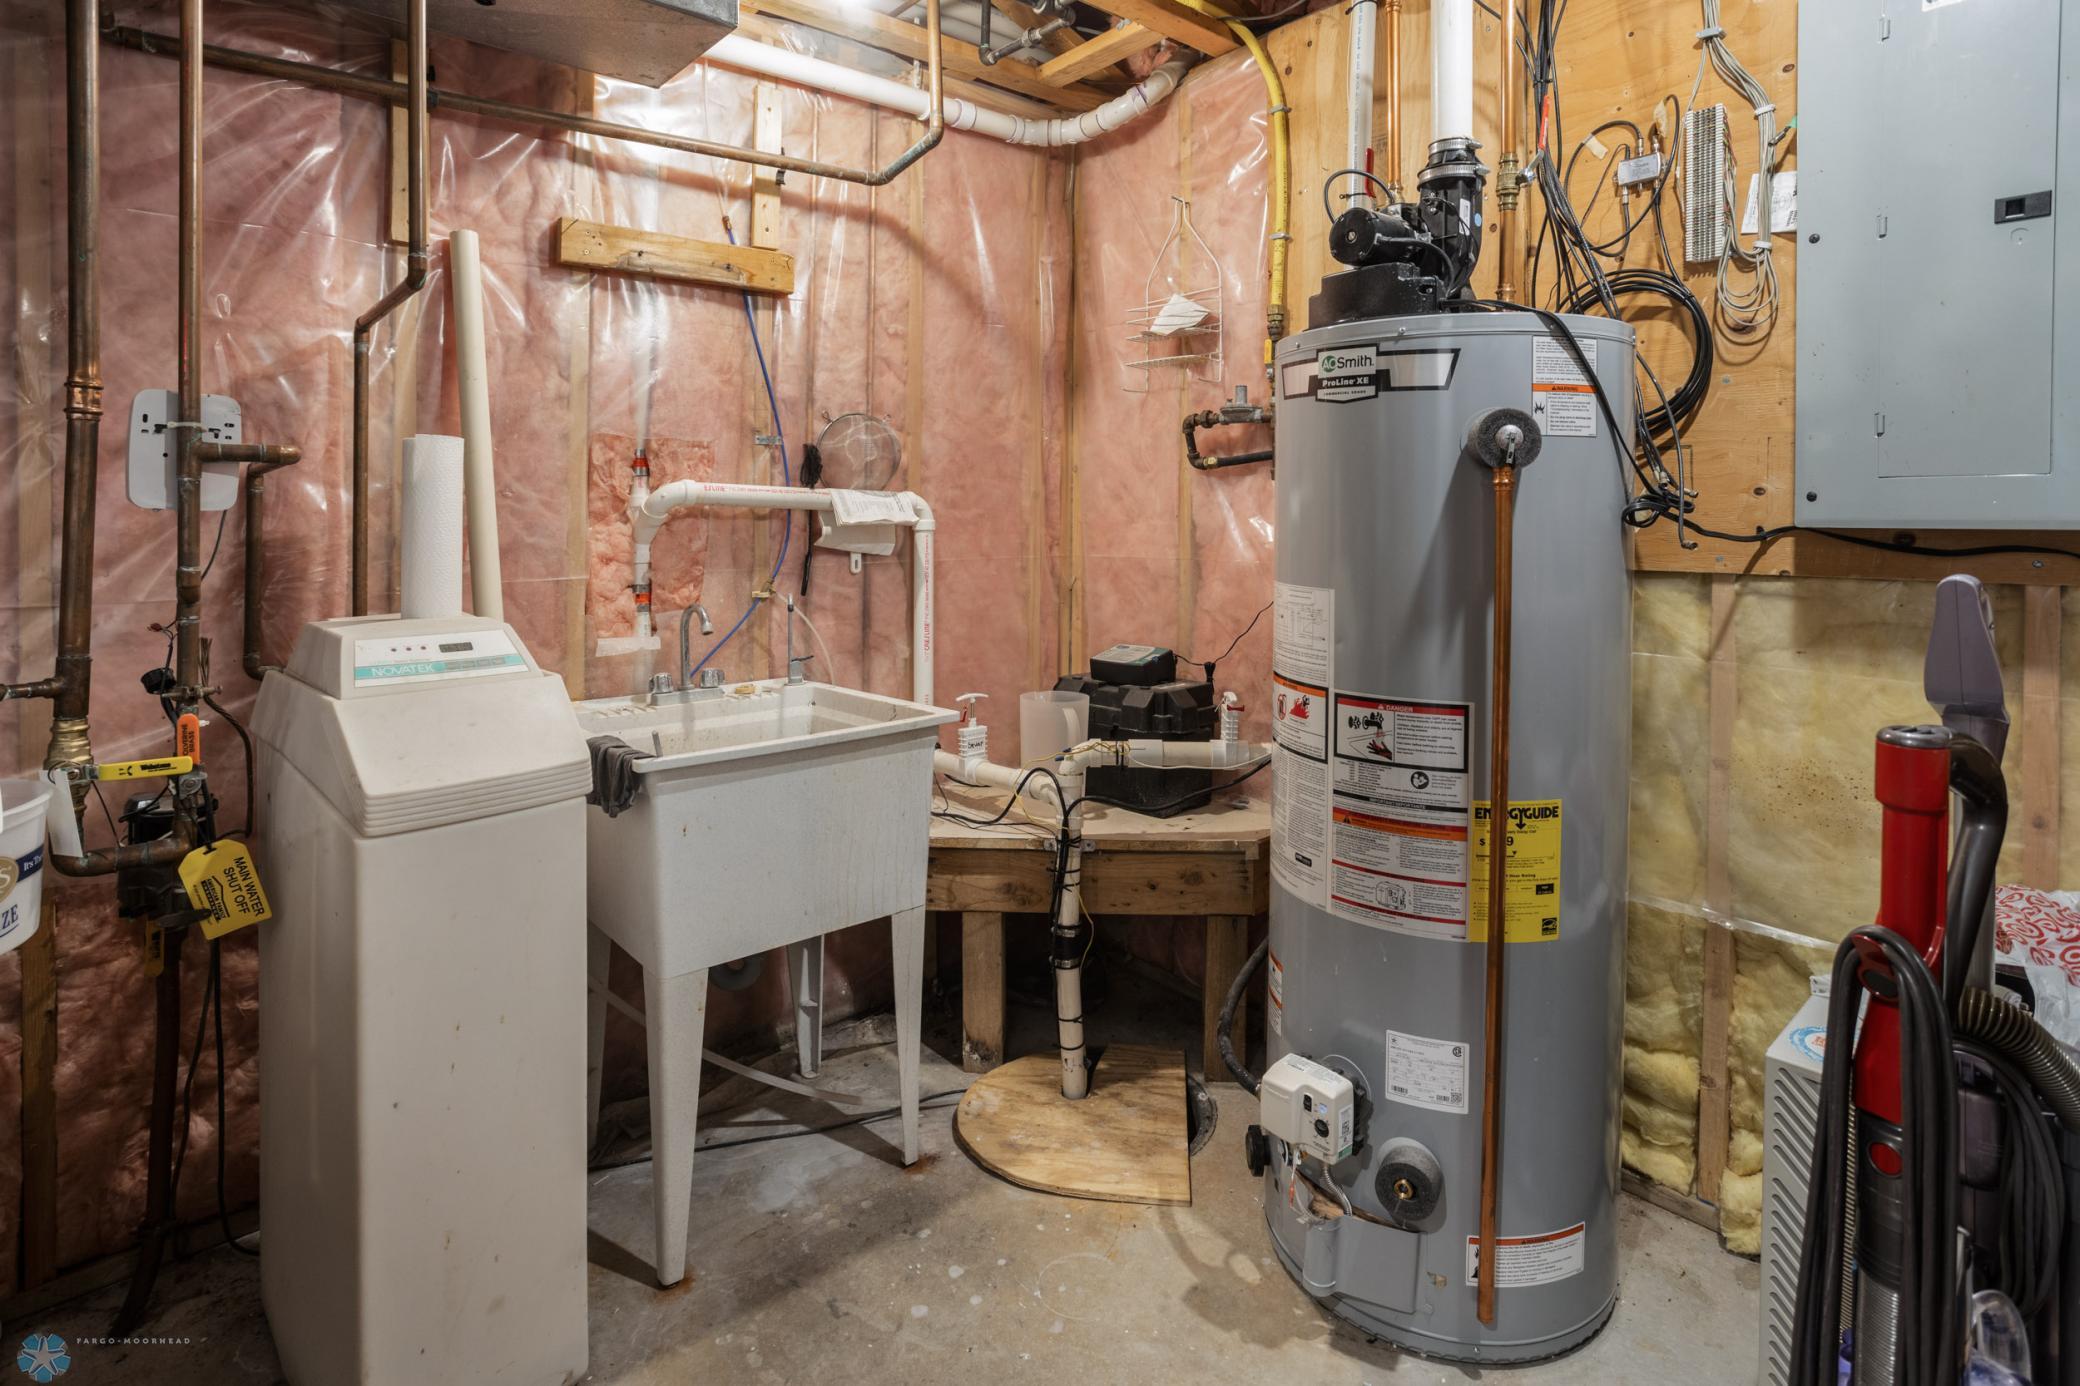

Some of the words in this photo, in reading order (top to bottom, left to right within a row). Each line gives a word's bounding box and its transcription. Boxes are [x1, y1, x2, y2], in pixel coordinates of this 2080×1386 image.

[1322, 377, 1355, 387] ProLine
[371, 663, 435, 677] NOVATEK
[1385, 704, 1414, 713] DANGER
[1474, 806, 1560, 820] ENGYGUIDE
[223, 867, 242, 893] SHUT
[234, 894, 251, 915] OFF
[233, 856, 252, 881] MAIN
[246, 881, 265, 917] WATER
